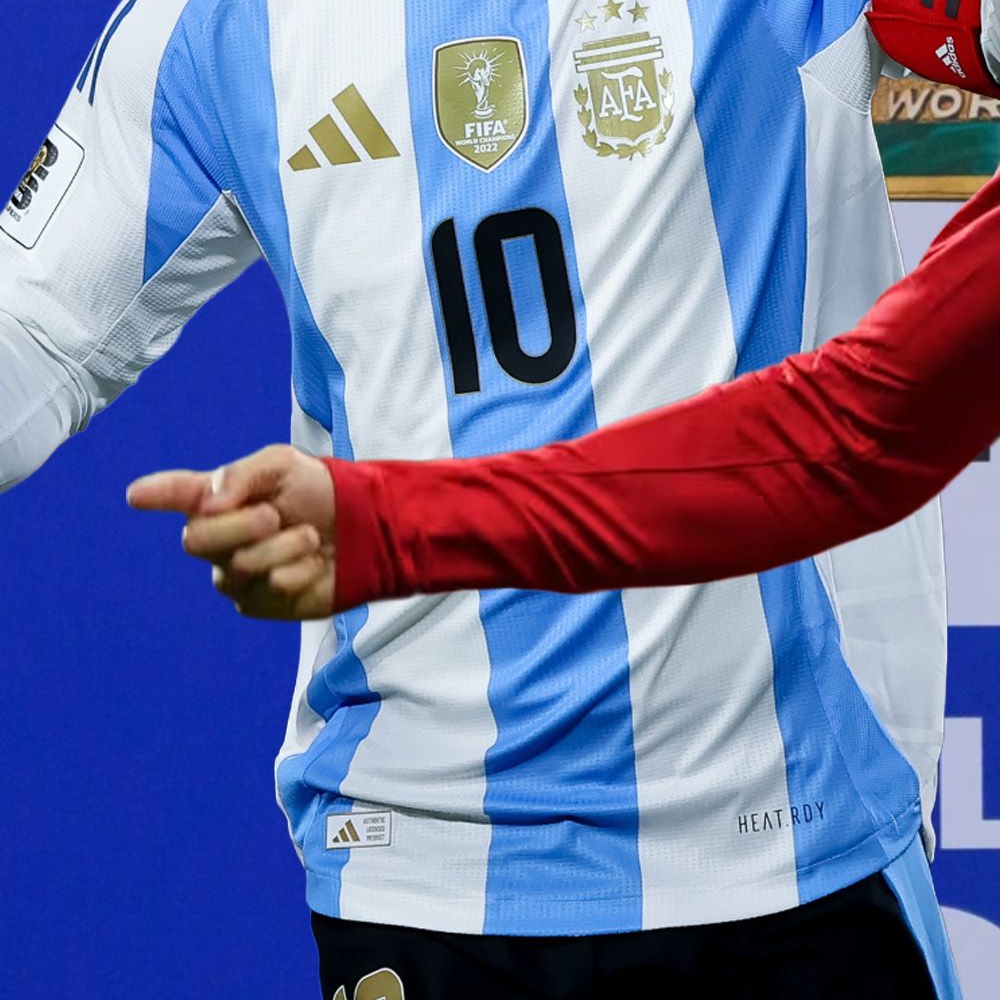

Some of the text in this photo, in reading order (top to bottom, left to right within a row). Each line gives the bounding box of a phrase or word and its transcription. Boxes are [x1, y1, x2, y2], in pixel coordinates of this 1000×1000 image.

[599, 66, 657, 122] AFA
[464, 120, 506, 139] FIFA
[473, 143, 499, 154] 2022
[431, 206, 577, 395] 10
[738, 801, 825, 835] HEAT.RDY
